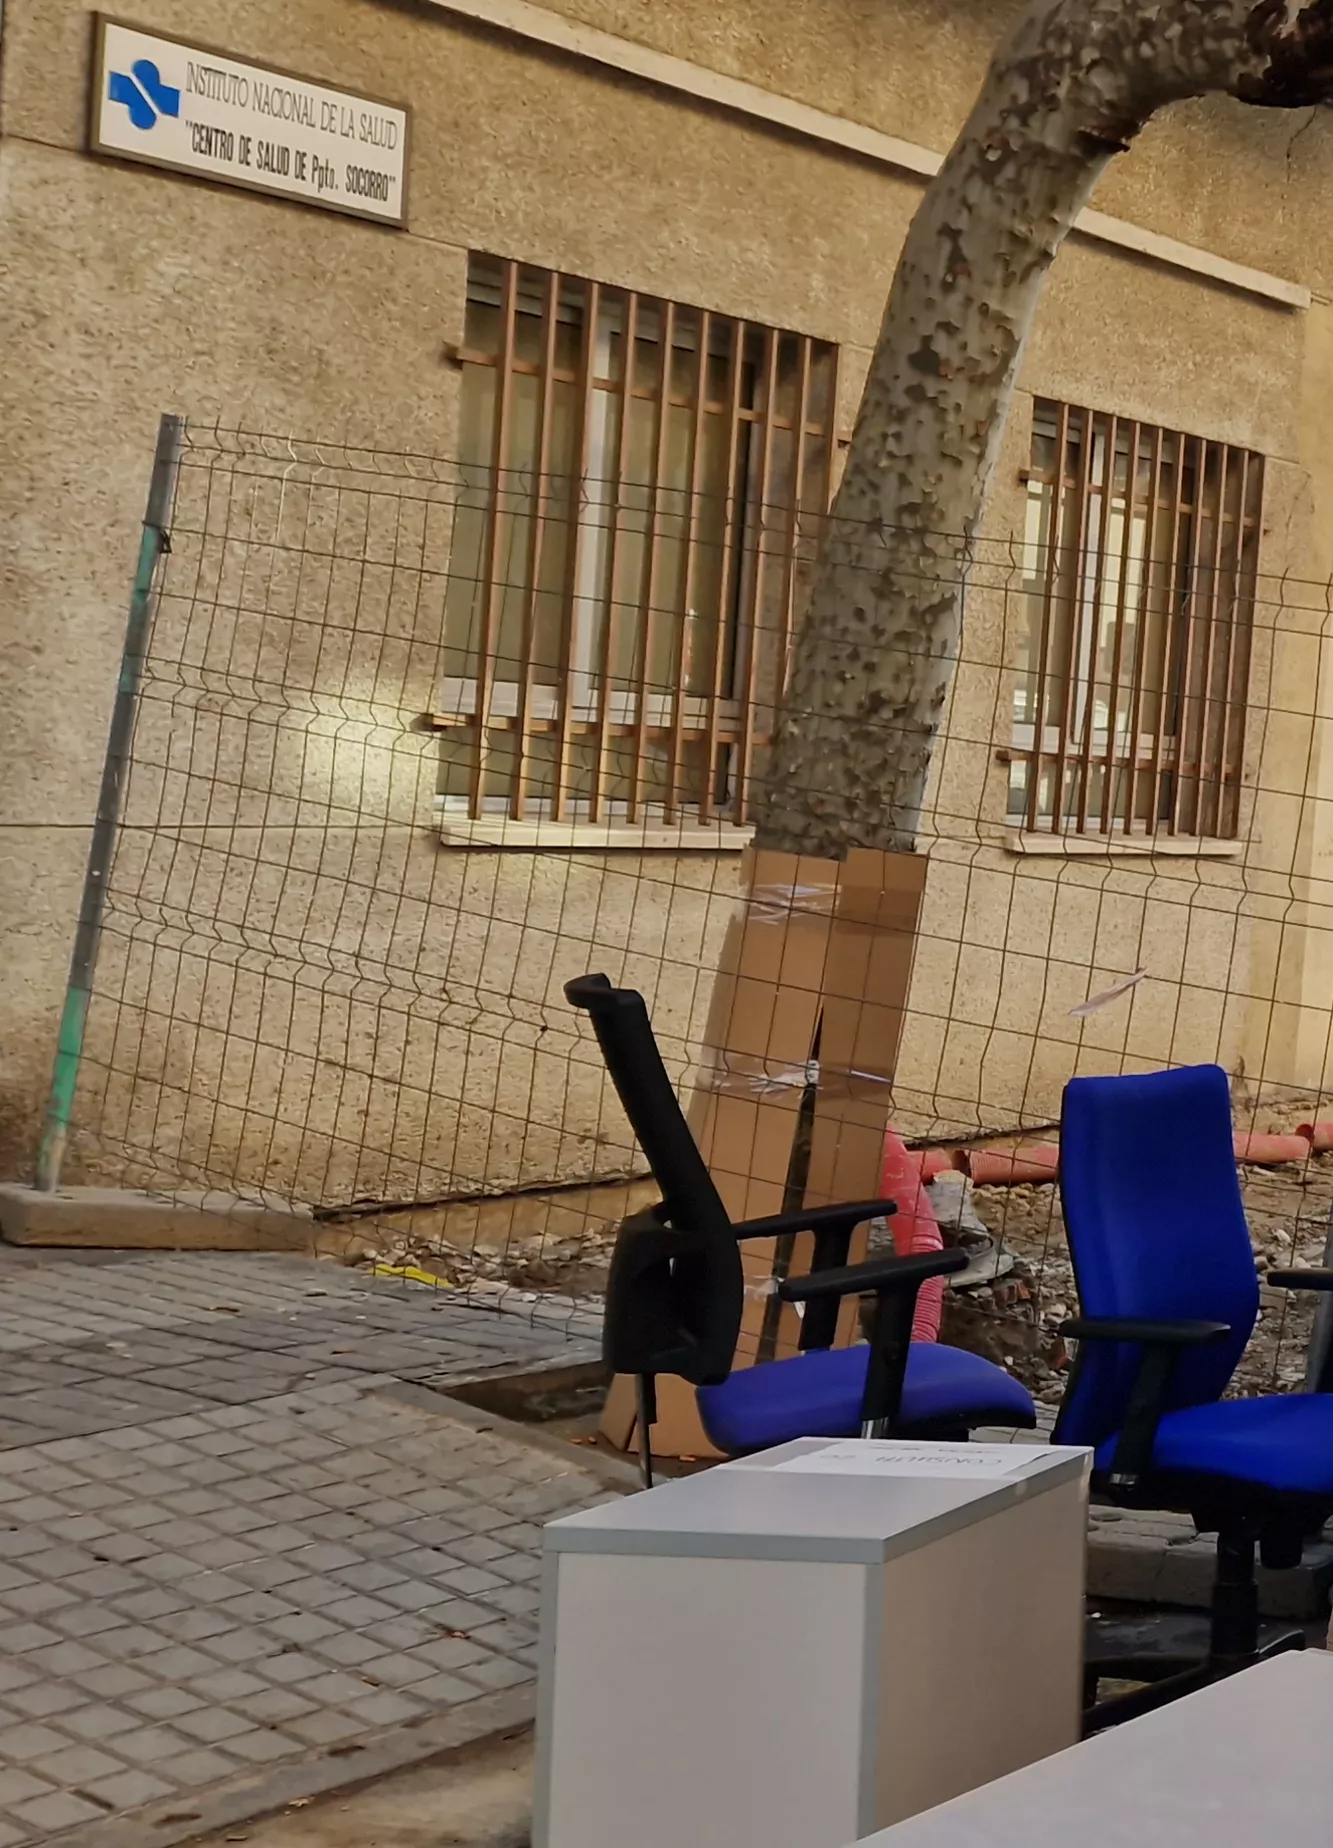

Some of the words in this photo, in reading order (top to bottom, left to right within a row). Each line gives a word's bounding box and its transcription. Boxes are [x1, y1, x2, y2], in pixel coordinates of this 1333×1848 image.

[186, 61, 249, 107] INSTITUTO
[252, 81, 316, 128] NACIONAL
[320, 101, 338, 134] DE
[340, 106, 355, 139] LA
[360, 113, 398, 150] SALUD
[238, 134, 252, 167] DE
[256, 140, 290, 176] SALUD
[294, 150, 307, 181] DE
[312, 154, 339, 193] Ppto.
